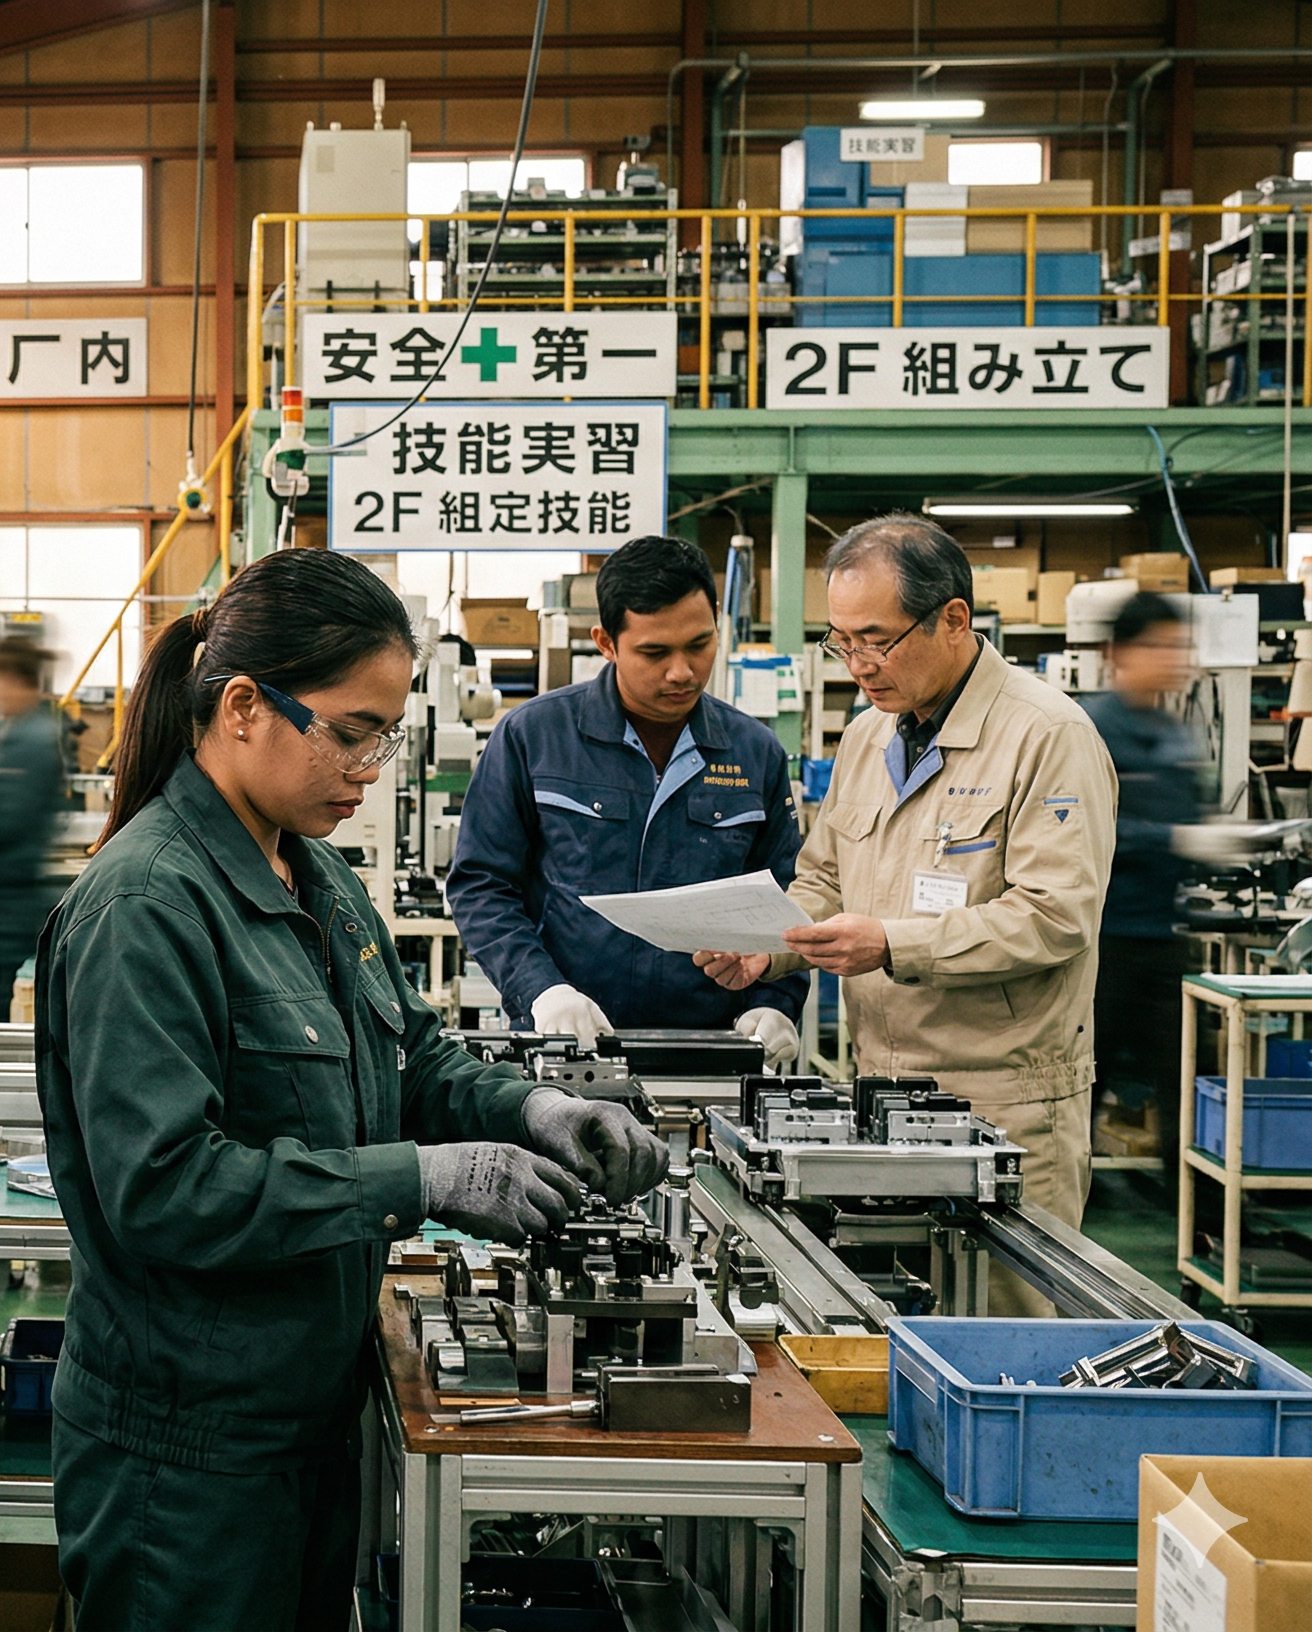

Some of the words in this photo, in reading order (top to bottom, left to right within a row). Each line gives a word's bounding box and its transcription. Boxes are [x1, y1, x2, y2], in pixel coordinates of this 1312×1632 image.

[321, 328, 446, 383] 安全
[531, 327, 657, 383] 第一
[784, 341, 880, 396] 2F
[902, 340, 1152, 396] 組み立て
[392, 422, 640, 475] 技能実習
[353, 491, 423, 533] 2F
[439, 490, 631, 534] 組定技能
